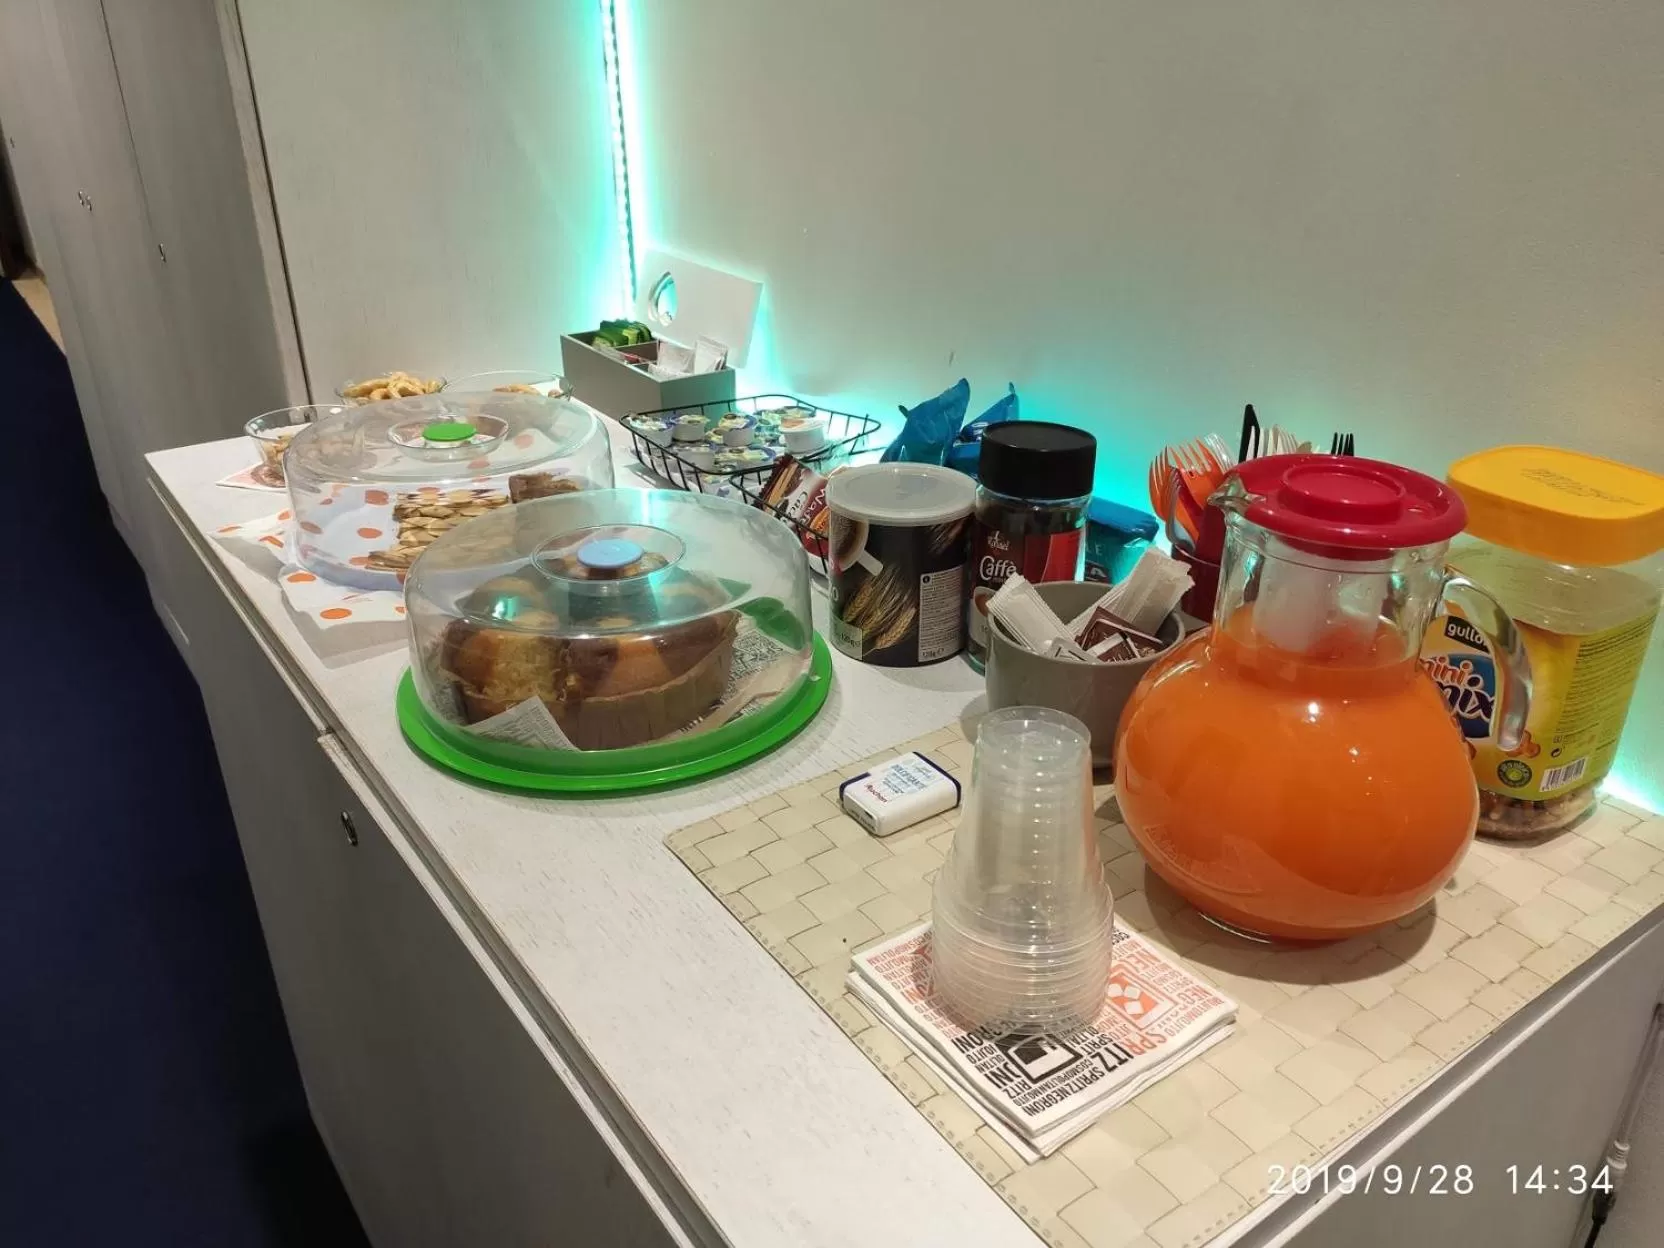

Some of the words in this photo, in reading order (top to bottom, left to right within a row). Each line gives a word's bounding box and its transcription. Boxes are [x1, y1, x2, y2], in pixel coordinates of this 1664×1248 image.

[980, 555, 1017, 581] Caffè
[1088, 1029, 1168, 1074] SPRITZ
[1002, 1079, 1033, 1099] RITZ
